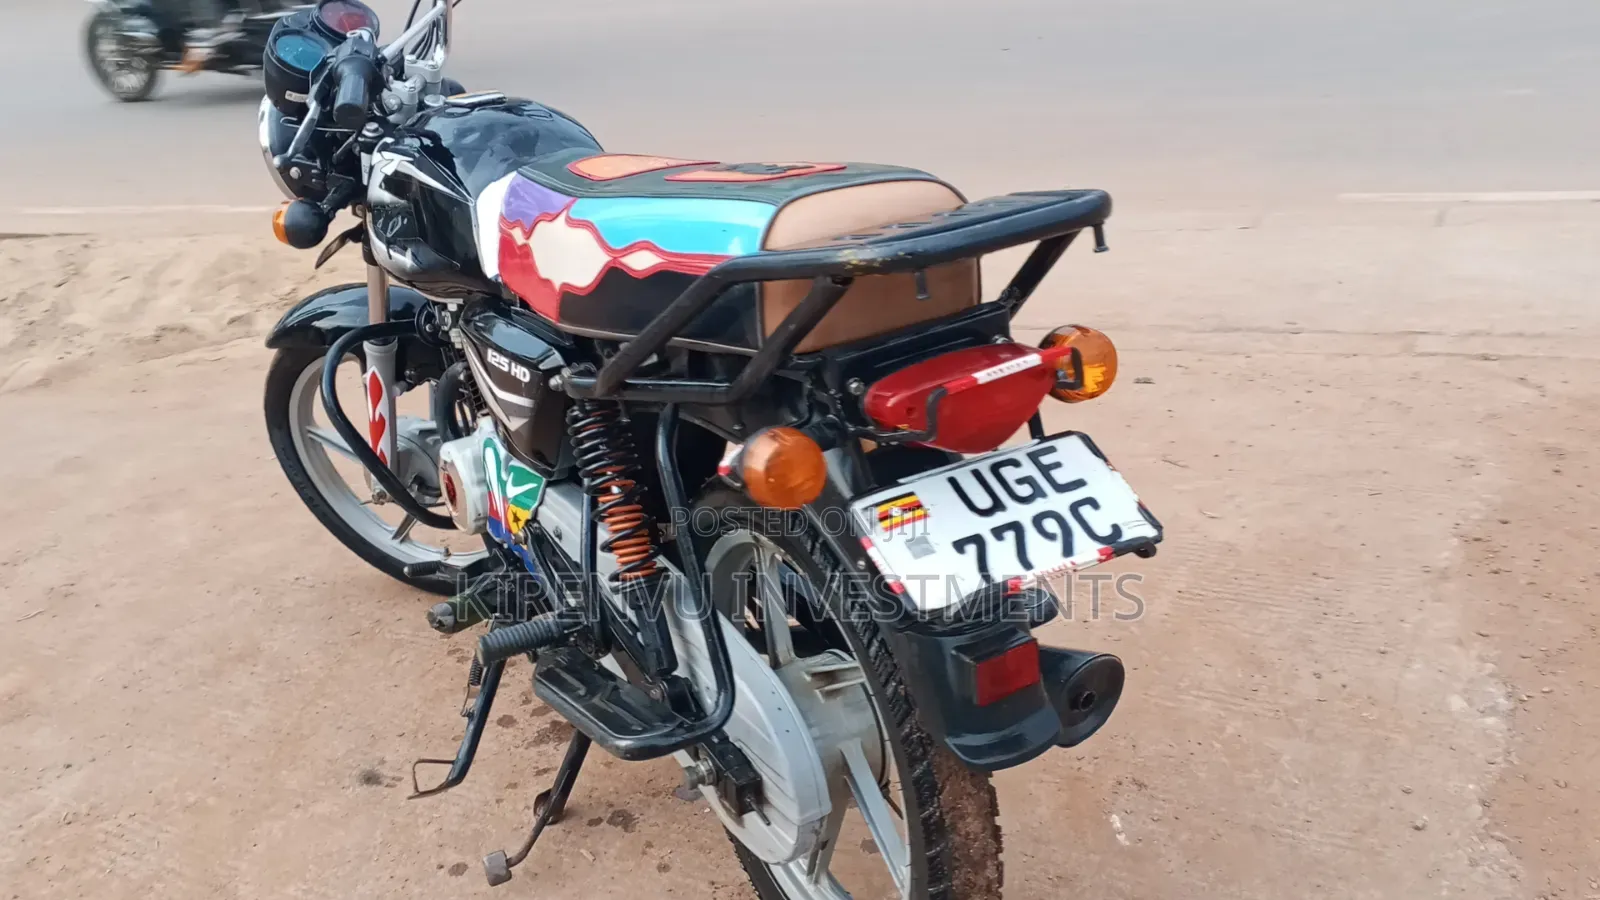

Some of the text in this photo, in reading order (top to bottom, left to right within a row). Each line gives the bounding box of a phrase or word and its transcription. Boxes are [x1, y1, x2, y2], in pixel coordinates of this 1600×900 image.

[486, 348, 531, 383] 125 HD
[947, 445, 1088, 518] UGE
[951, 496, 1123, 585] 779C
